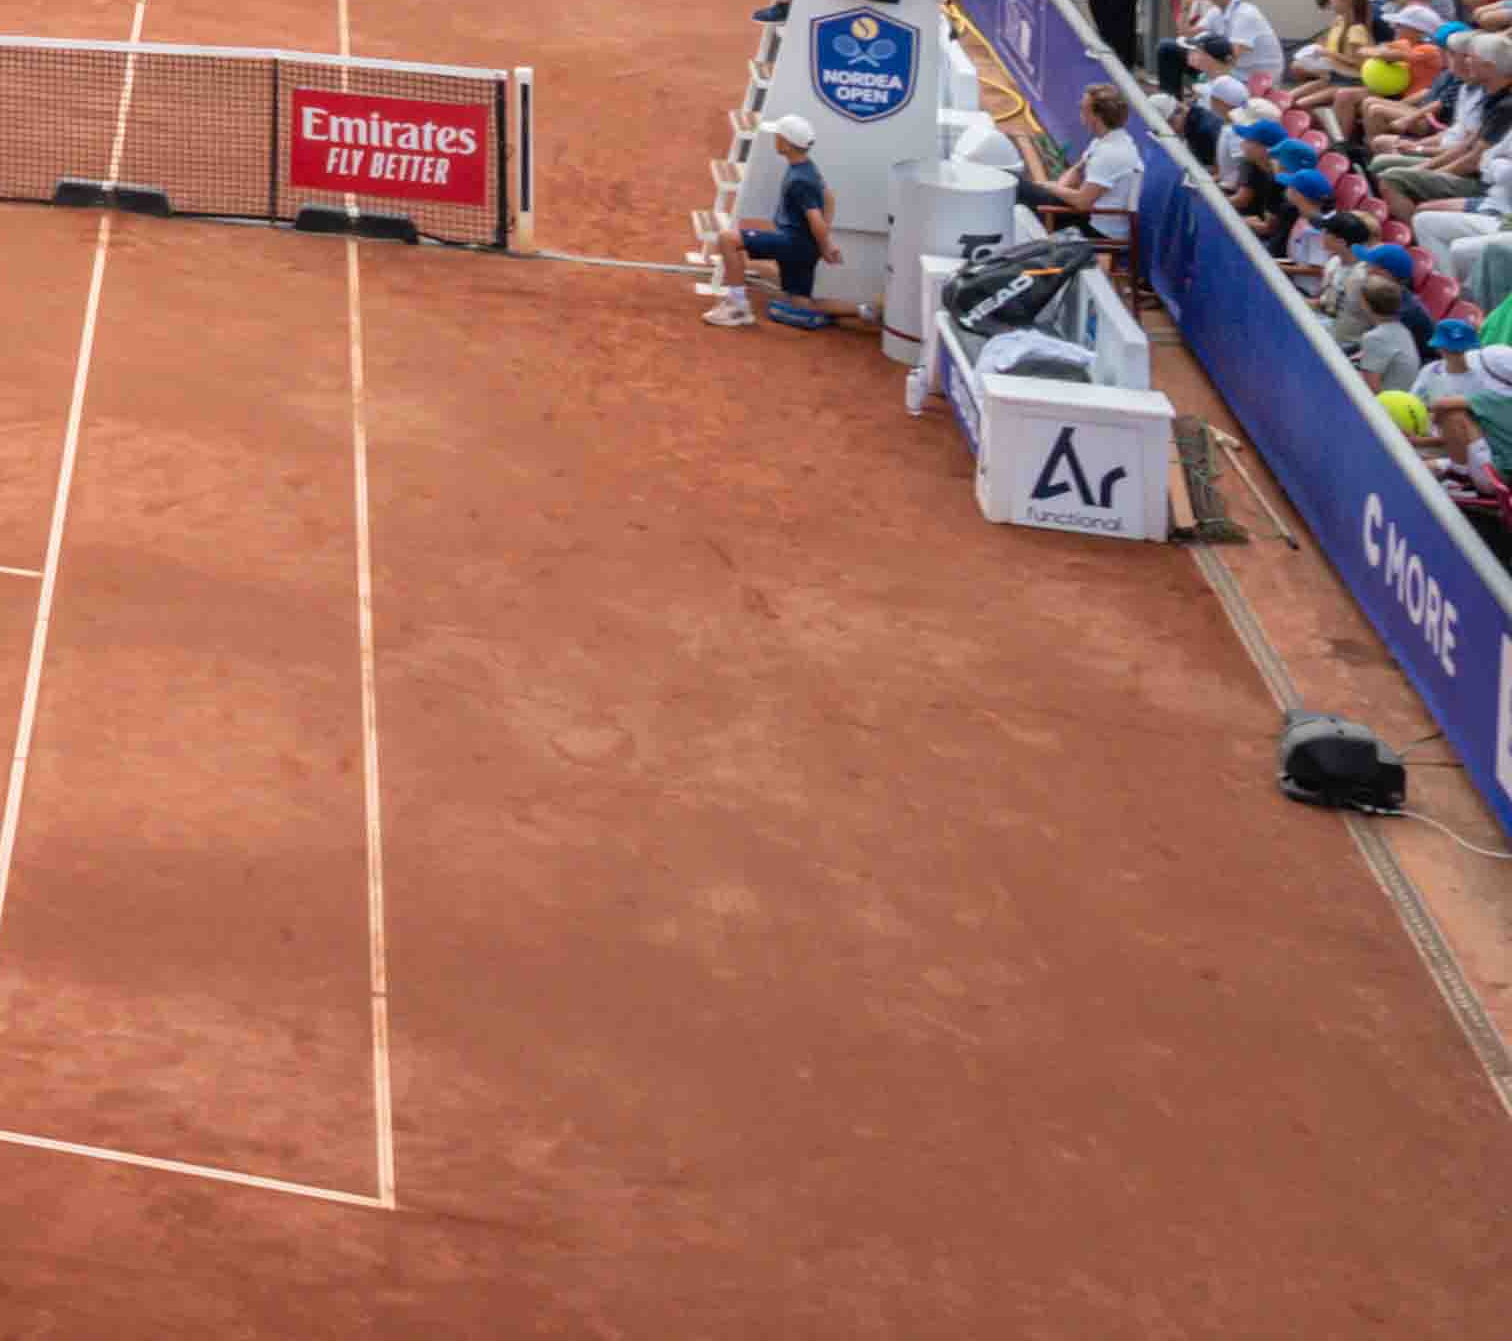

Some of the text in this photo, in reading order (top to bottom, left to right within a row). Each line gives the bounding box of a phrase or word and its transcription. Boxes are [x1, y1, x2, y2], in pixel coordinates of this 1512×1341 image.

[823, 69, 903, 90] NORDEA
[835, 85, 888, 104] OPEN
[301, 106, 477, 155] Emirates
[325, 147, 450, 185] FLY BETTER
[959, 274, 1034, 327] HEAD
[1365, 492, 1459, 677] C MORE
